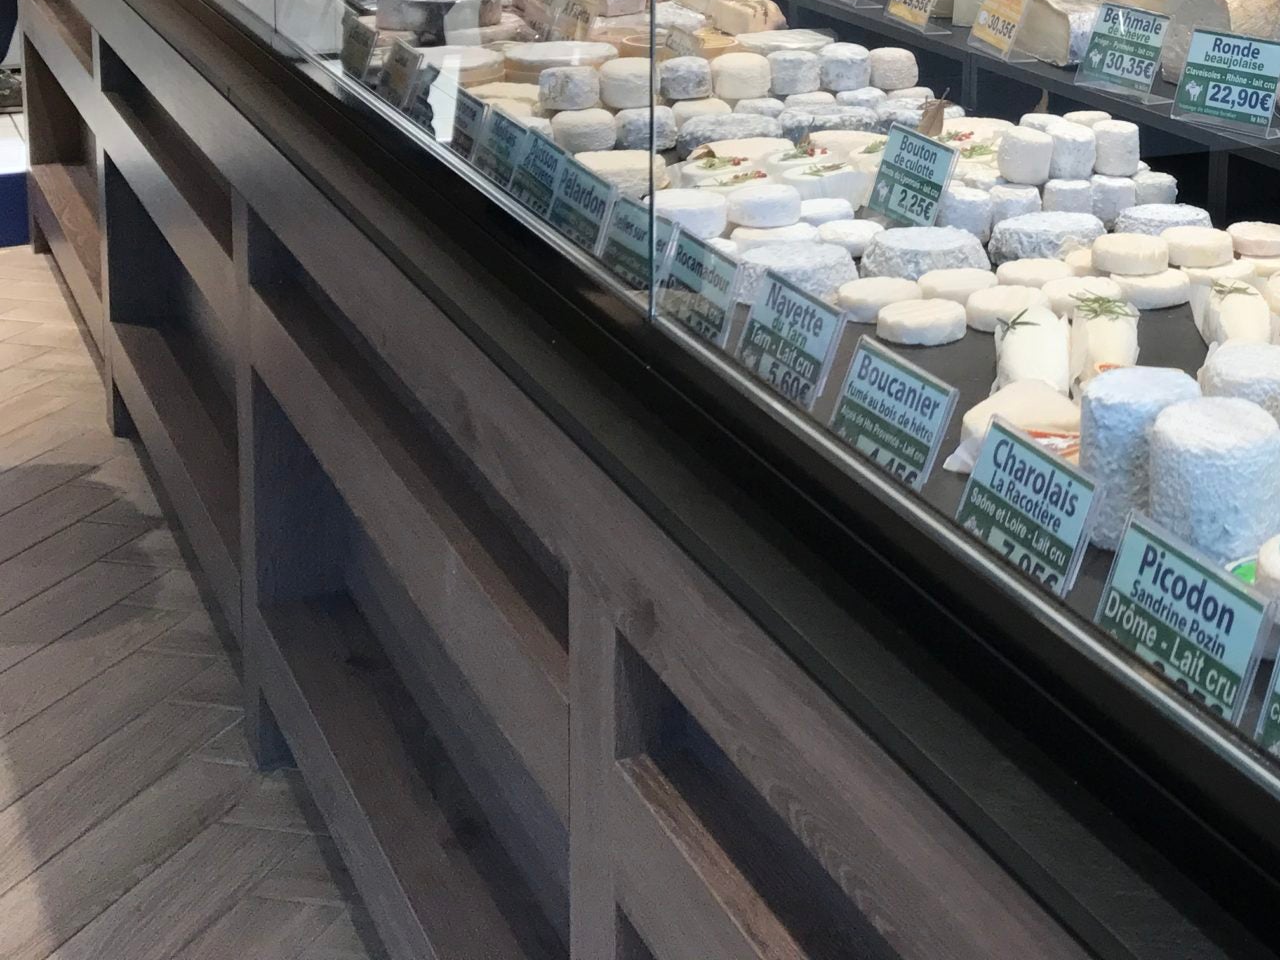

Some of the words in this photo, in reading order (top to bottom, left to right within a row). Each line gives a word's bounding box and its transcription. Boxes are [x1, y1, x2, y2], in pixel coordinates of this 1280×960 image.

[1103, 7, 1162, 35] Behmale
[1106, 52, 1154, 79] 30,35€
[1204, 51, 1265, 72] beaujolaise
[1212, 37, 1260, 60] Ronde
[1209, 83, 1273, 111] 22,90€
[1264, 81, 1276, 90] cru
[894, 152, 903, 167] de
[904, 158, 934, 180] culotte
[899, 134, 938, 164] Bouton
[559, 166, 606, 221] Pélardon
[674, 243, 730, 295] Rocamadour
[765, 282, 824, 338] Navette
[776, 343, 798, 368] Lait
[796, 357, 815, 379] cru
[847, 380, 869, 405] fumé
[867, 395, 879, 410] au
[878, 399, 898, 420] bois
[898, 411, 910, 429] de
[856, 354, 940, 421] Boucanier
[989, 470, 1004, 493] La
[1003, 480, 1062, 533] Racotière
[992, 438, 1079, 518] Charolais
[970, 486, 995, 517] Saône
[995, 507, 1006, 523] et
[1004, 513, 1027, 539] Loire
[1031, 530, 1050, 557] Lait
[1049, 545, 1067, 567] cru
[1138, 543, 1235, 637] Picodon
[1130, 579, 1188, 632] Sandrine
[1188, 618, 1226, 660] Pozin
[1105, 590, 1158, 647] Drôme
[1169, 636, 1206, 682] Lait
[1205, 669, 1237, 706] cru
